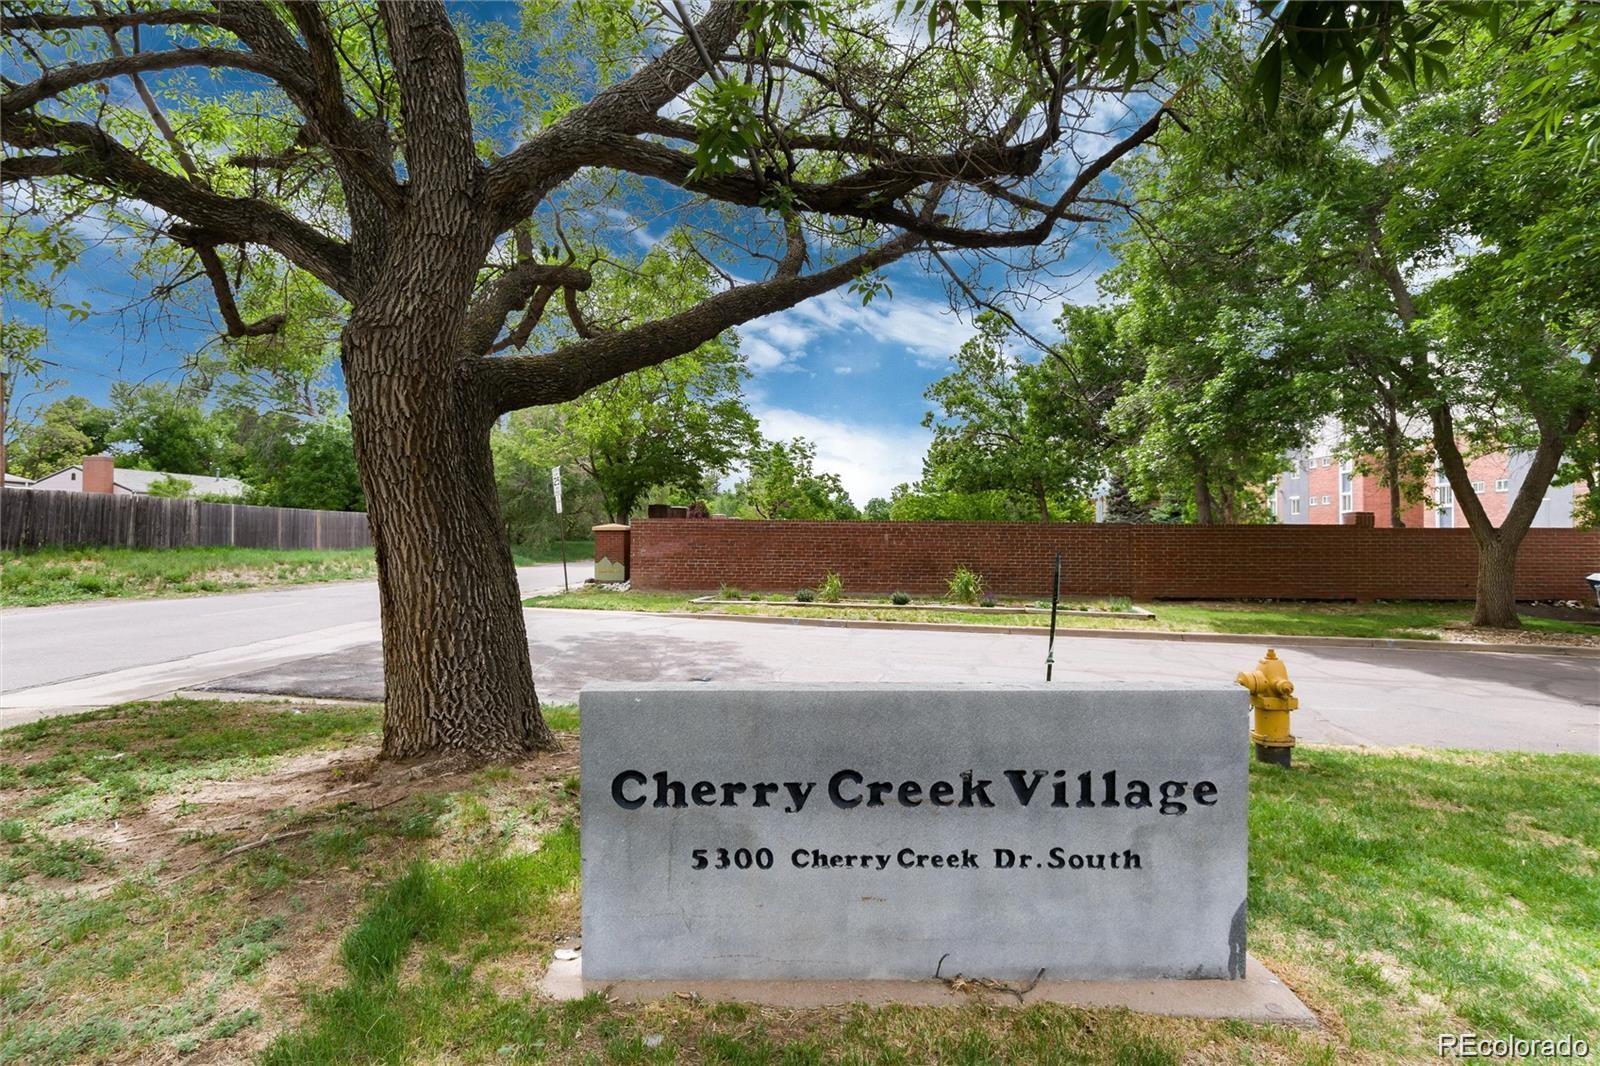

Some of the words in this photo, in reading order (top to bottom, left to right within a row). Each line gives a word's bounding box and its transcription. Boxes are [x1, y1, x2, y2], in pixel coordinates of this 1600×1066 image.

[610, 769, 817, 814] Cherry
[827, 768, 996, 811] Creek
[1002, 769, 1219, 816] Village
[691, 847, 774, 871] 5300
[791, 848, 892, 871] Cherry
[896, 847, 979, 870] Creek
